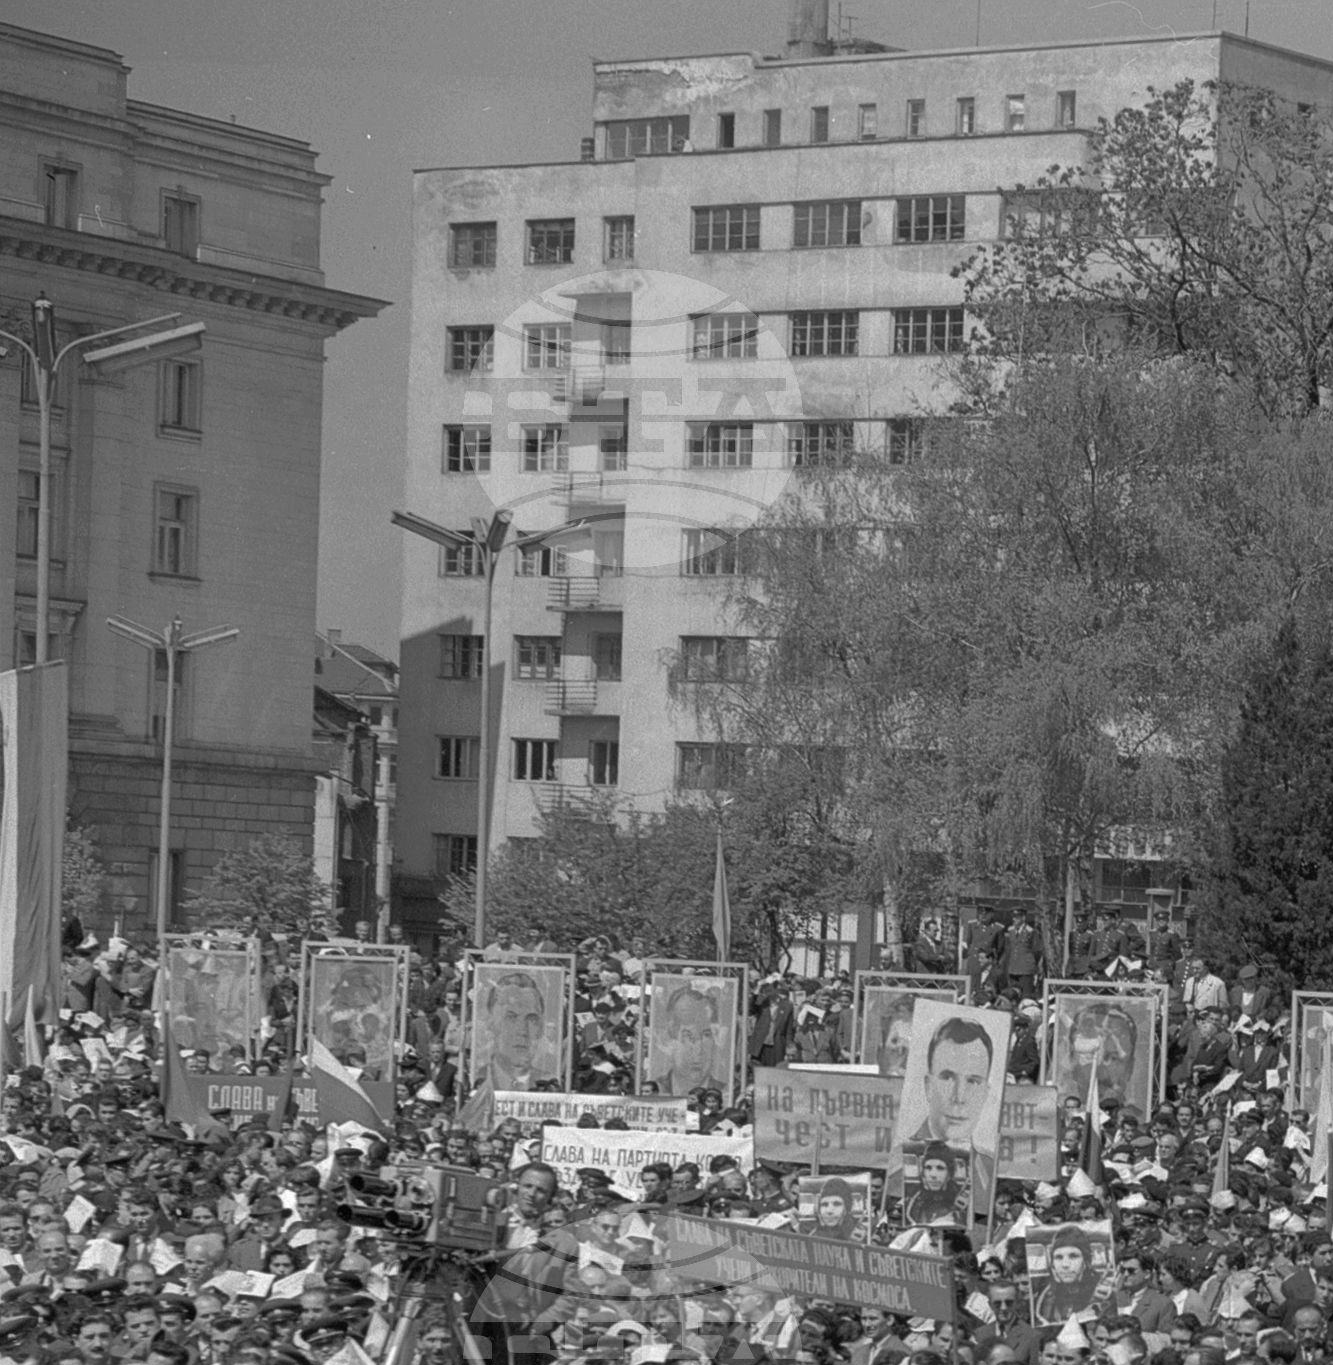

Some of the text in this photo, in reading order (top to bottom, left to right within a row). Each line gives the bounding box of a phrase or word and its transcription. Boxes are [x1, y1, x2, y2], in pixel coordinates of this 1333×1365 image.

[208, 1084, 264, 1111] СЛАВА
[494, 1100, 516, 1118] ЕСТ
[564, 1102, 579, 1119] НА
[543, 1144, 585, 1166] СЛАВА
[592, 1148, 611, 1167] НА
[855, 1248, 865, 1273] И
[868, 1251, 948, 1289] СЪВЕТСКИТЕ
[832, 1274, 851, 1300] НА
